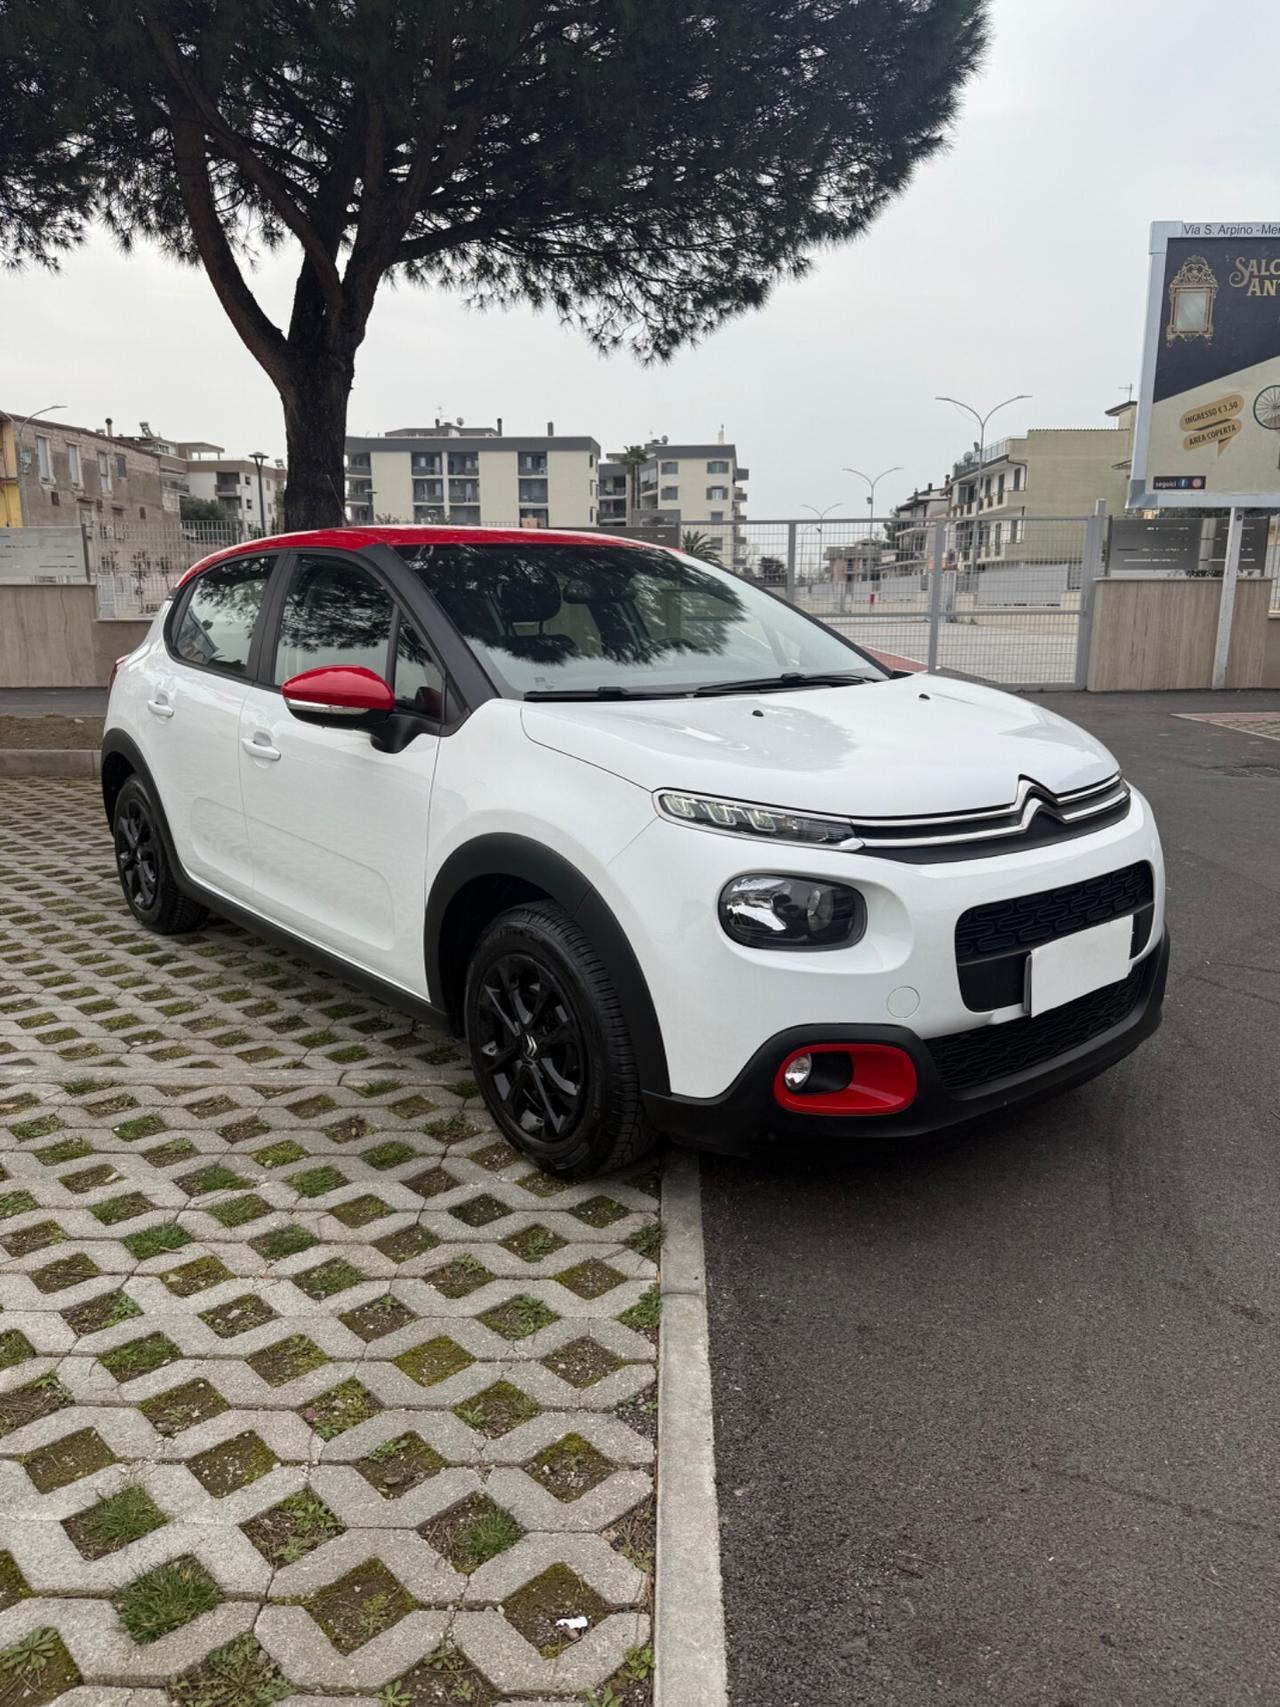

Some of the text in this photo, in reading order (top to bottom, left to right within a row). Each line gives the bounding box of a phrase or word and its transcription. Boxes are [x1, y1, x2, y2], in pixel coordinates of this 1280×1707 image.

[1184, 224, 1200, 235] Via
[1204, 224, 1215, 235] S.
[1218, 224, 1253, 236] Arpino
[1246, 278, 1280, 296] AN
[1185, 408, 1217, 424] INGRESSO
[1189, 424, 1237, 445] AREA COPERTA
